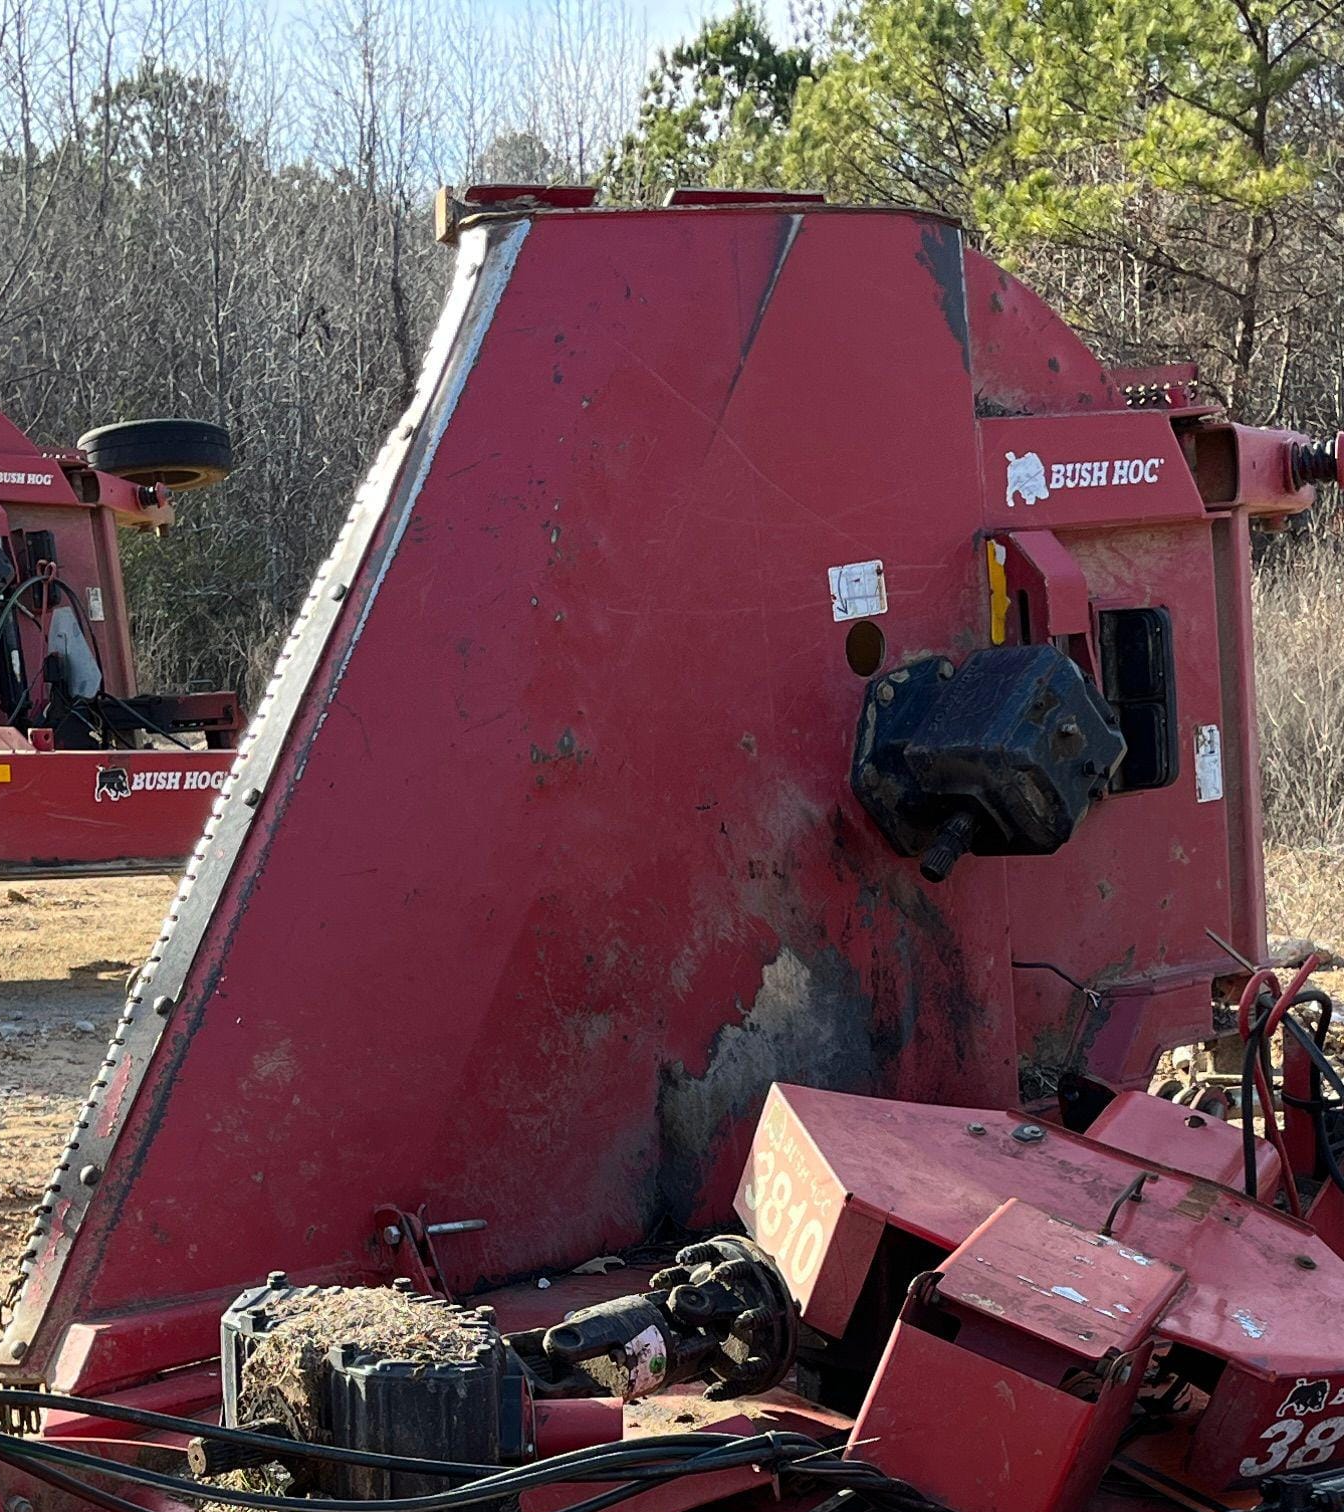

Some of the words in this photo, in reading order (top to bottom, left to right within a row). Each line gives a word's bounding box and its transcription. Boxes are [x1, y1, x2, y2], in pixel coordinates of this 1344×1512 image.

[27, 473, 52, 485] HOG
[1050, 461, 1110, 489] BUSH
[131, 771, 182, 791] BUSH
[183, 771, 225, 790] HOG
[744, 1150, 824, 1286] 3810
